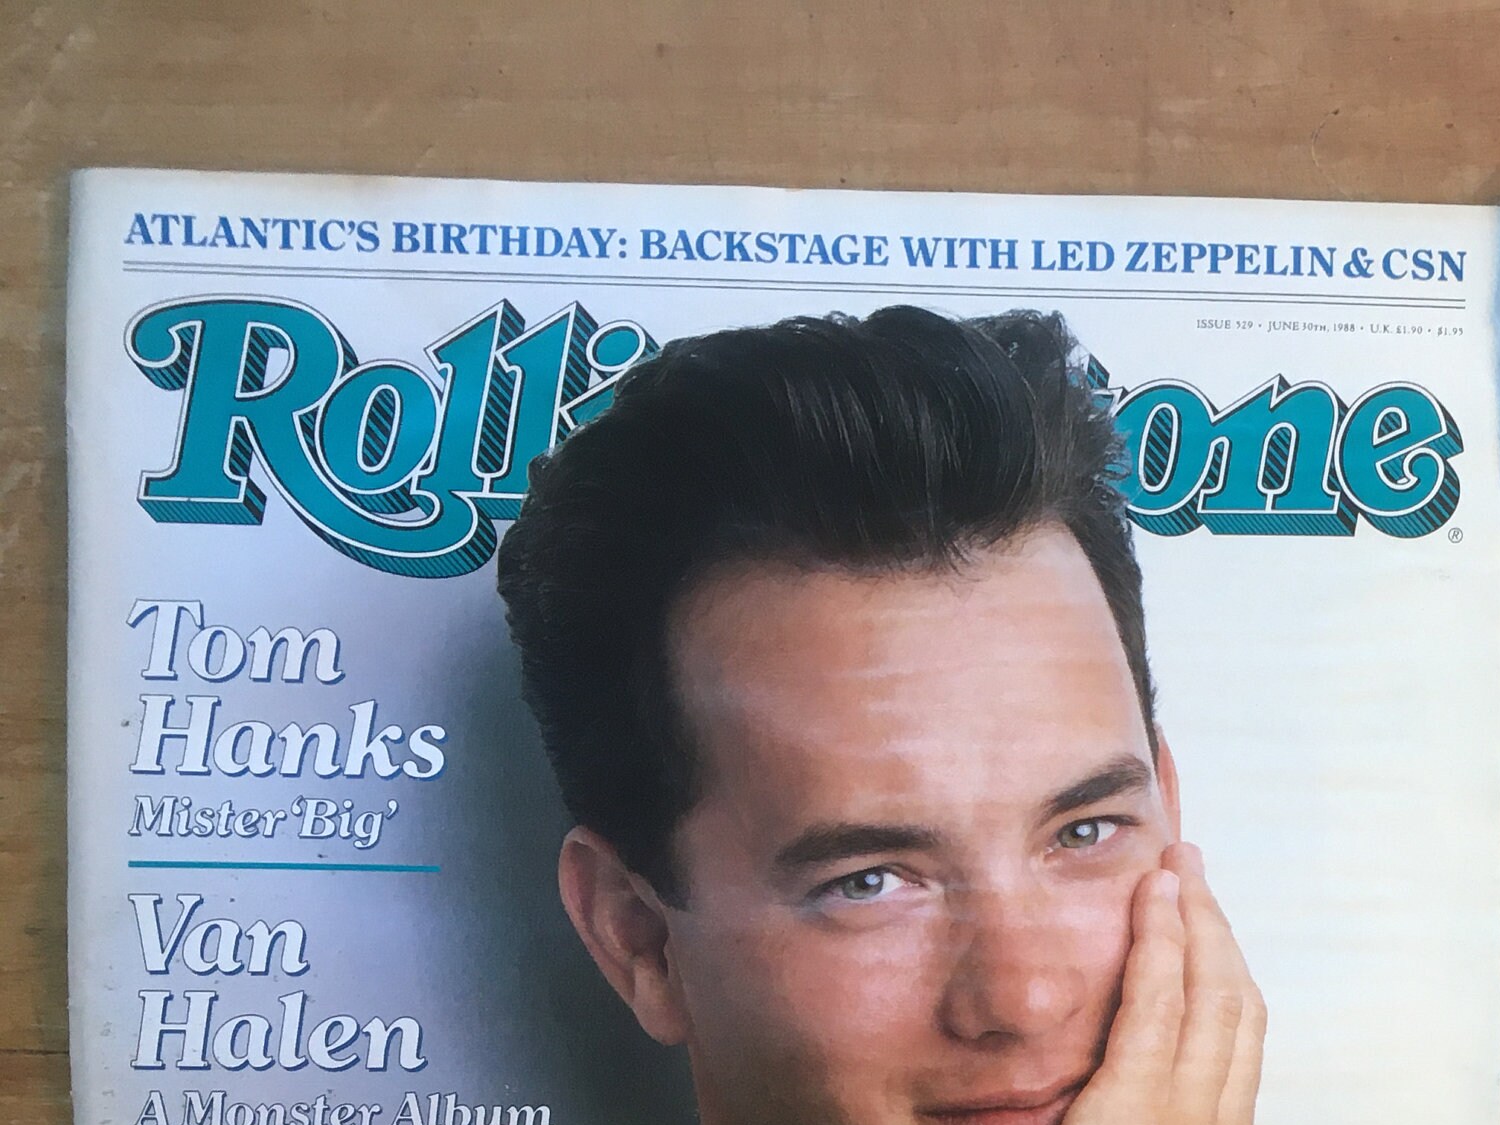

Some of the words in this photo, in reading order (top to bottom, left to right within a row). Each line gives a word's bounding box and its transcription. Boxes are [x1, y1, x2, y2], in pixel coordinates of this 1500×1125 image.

[125, 212, 379, 253] ATLANTIC'S
[392, 221, 628, 260] BIRTHDAY:
[640, 229, 889, 266] BACKSTAGE
[900, 236, 1016, 271] WITH
[1031, 239, 1116, 273] LED
[1125, 241, 1336, 278] ZEPPELIN
[1342, 248, 1375, 279] &
[1382, 248, 1467, 282] CSN
[1196, 319, 1232, 330] ISSUE
[1235, 320, 1254, 330] 529
[1267, 320, 1300, 332] JUNE
[1333, 322, 1355, 332] 1988
[125, 598, 345, 685] Tom
[128, 694, 449, 780] Hanks
[128, 795, 286, 839] Mister
[128, 893, 309, 976] Van
[131, 989, 427, 1073] Halen
